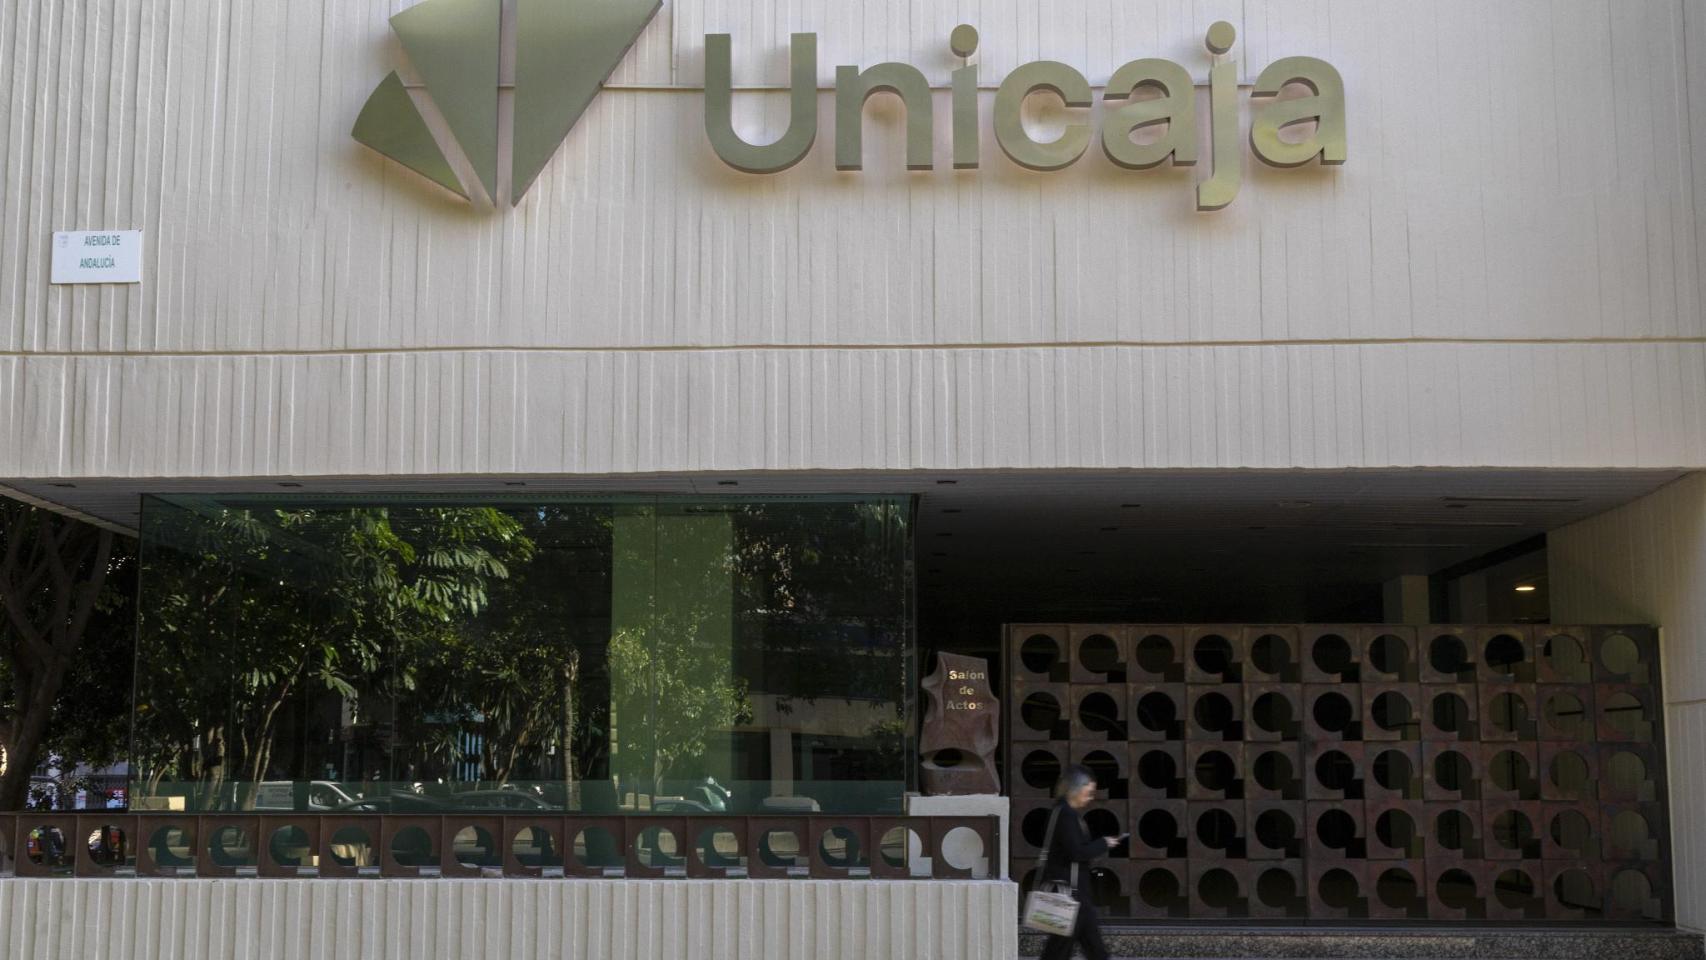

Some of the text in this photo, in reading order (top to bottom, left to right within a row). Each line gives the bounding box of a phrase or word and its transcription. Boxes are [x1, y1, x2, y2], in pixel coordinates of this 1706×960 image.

[704, 21, 1347, 212] Unicaja
[84, 235, 121, 246] AVENIDA DE
[80, 254, 115, 269] ANDALUCÍA
[959, 685, 975, 695] de
[946, 700, 985, 710] Actos
